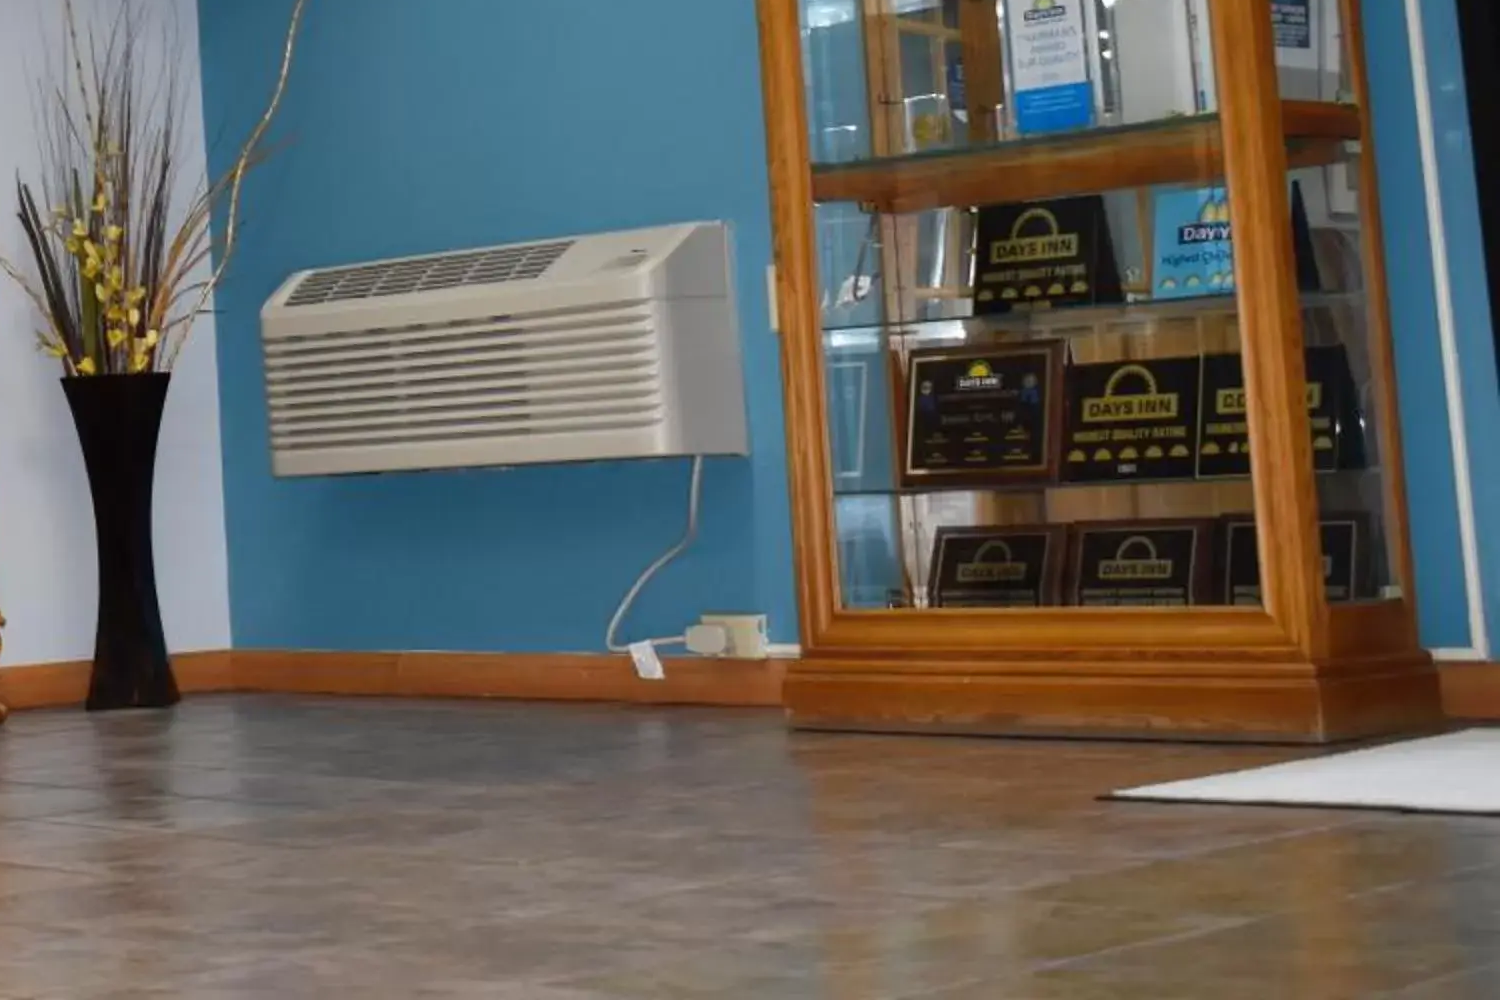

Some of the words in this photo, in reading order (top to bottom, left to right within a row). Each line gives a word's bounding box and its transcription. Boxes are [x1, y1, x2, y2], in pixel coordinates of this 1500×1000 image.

[995, 241, 1038, 259] DAYS
[1040, 238, 1072, 256] INN
[1088, 401, 1134, 419] DAYS
[1137, 399, 1173, 415] INN
